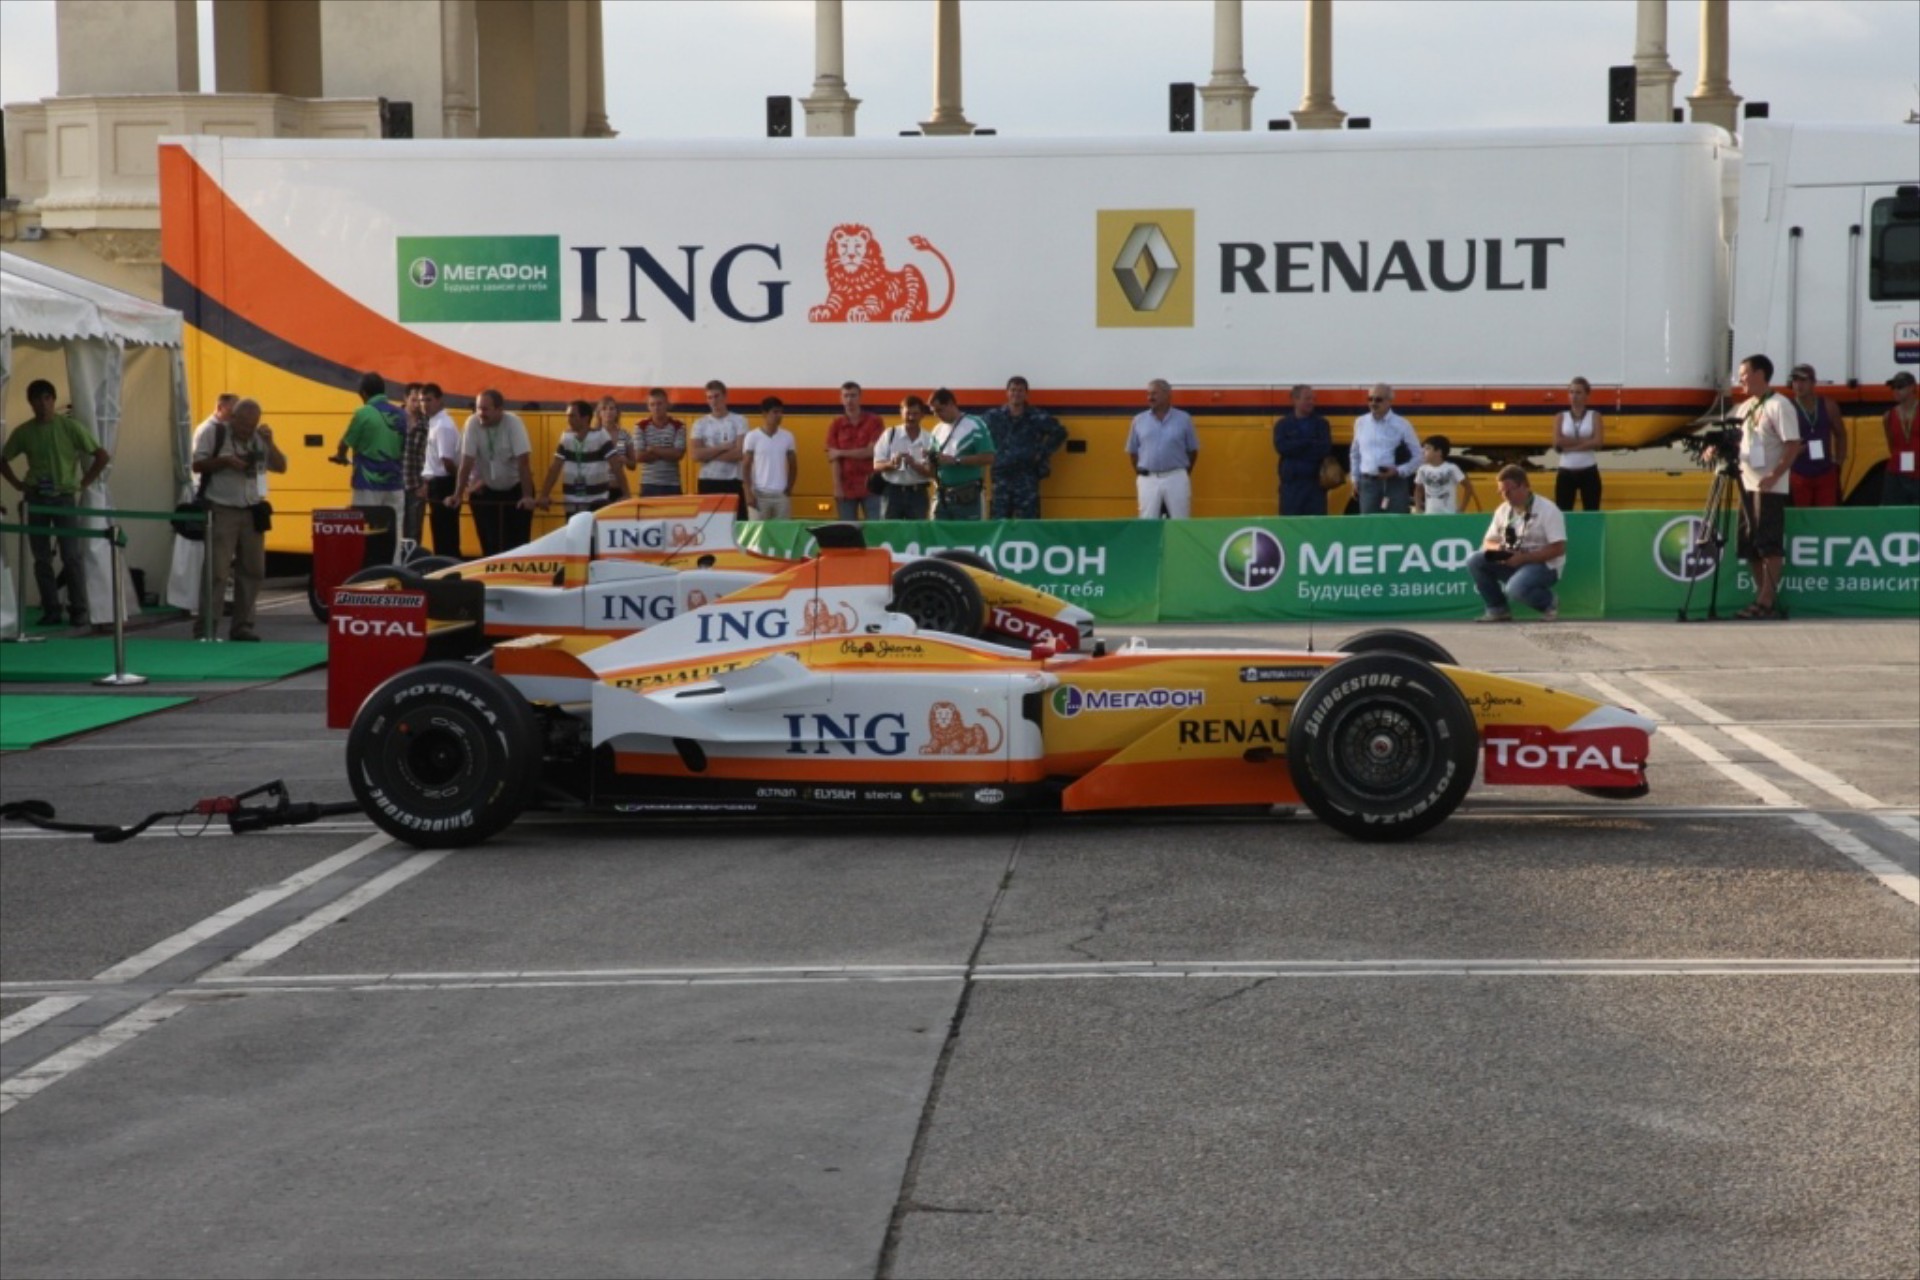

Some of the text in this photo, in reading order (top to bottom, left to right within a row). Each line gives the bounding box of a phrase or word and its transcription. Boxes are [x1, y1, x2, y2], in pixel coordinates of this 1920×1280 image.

[1218, 238, 1565, 293] RENAULT
[570, 243, 791, 323] ING
[314, 523, 364, 534] TOTAL
[608, 528, 662, 548] ING
[1299, 539, 1473, 576] МЕГАФ
[1062, 580, 1104, 597] тебя
[1298, 581, 1384, 601] Будущее
[1389, 581, 1468, 598] зависит
[1737, 573, 1829, 593] Буущее
[602, 595, 677, 620] ING
[332, 615, 424, 637] TOTAL
[695, 608, 790, 643] ING
[394, 683, 498, 726] POTENZA
[1304, 674, 1402, 739] BRIDGESTONE
[783, 712, 910, 755] ING
[1179, 719, 1287, 744] RENAU
[1487, 738, 1639, 770] TOTAL
[864, 789, 902, 800] steria
[1362, 760, 1456, 824] POTENZA
[370, 789, 475, 831] BRIDGESTONE
